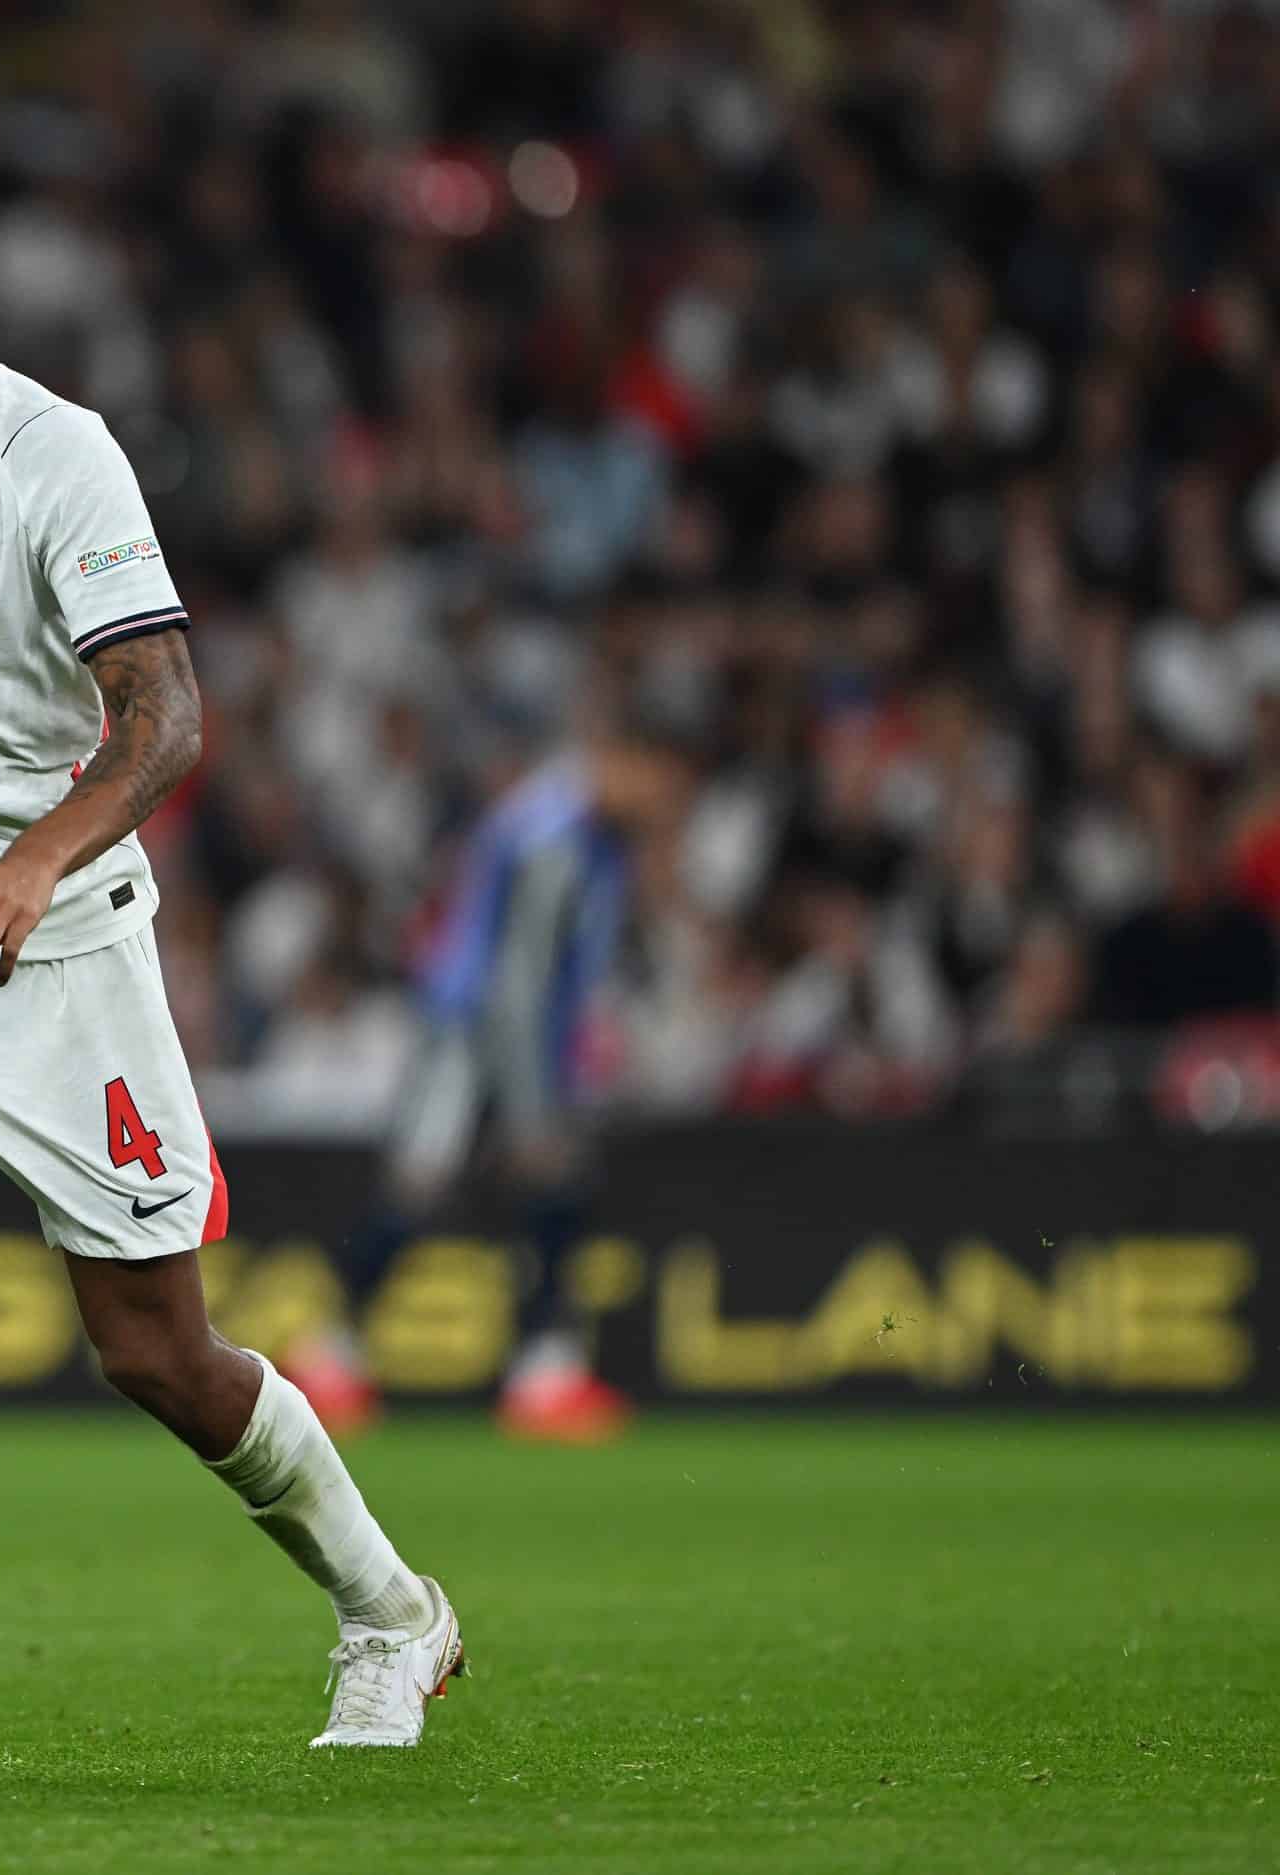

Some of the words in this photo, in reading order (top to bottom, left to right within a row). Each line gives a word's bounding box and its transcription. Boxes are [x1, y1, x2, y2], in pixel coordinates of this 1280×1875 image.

[79, 539, 157, 574] FOUNDATION
[104, 1075, 169, 1181] 4
[660, 1233, 1258, 1389] LANE
